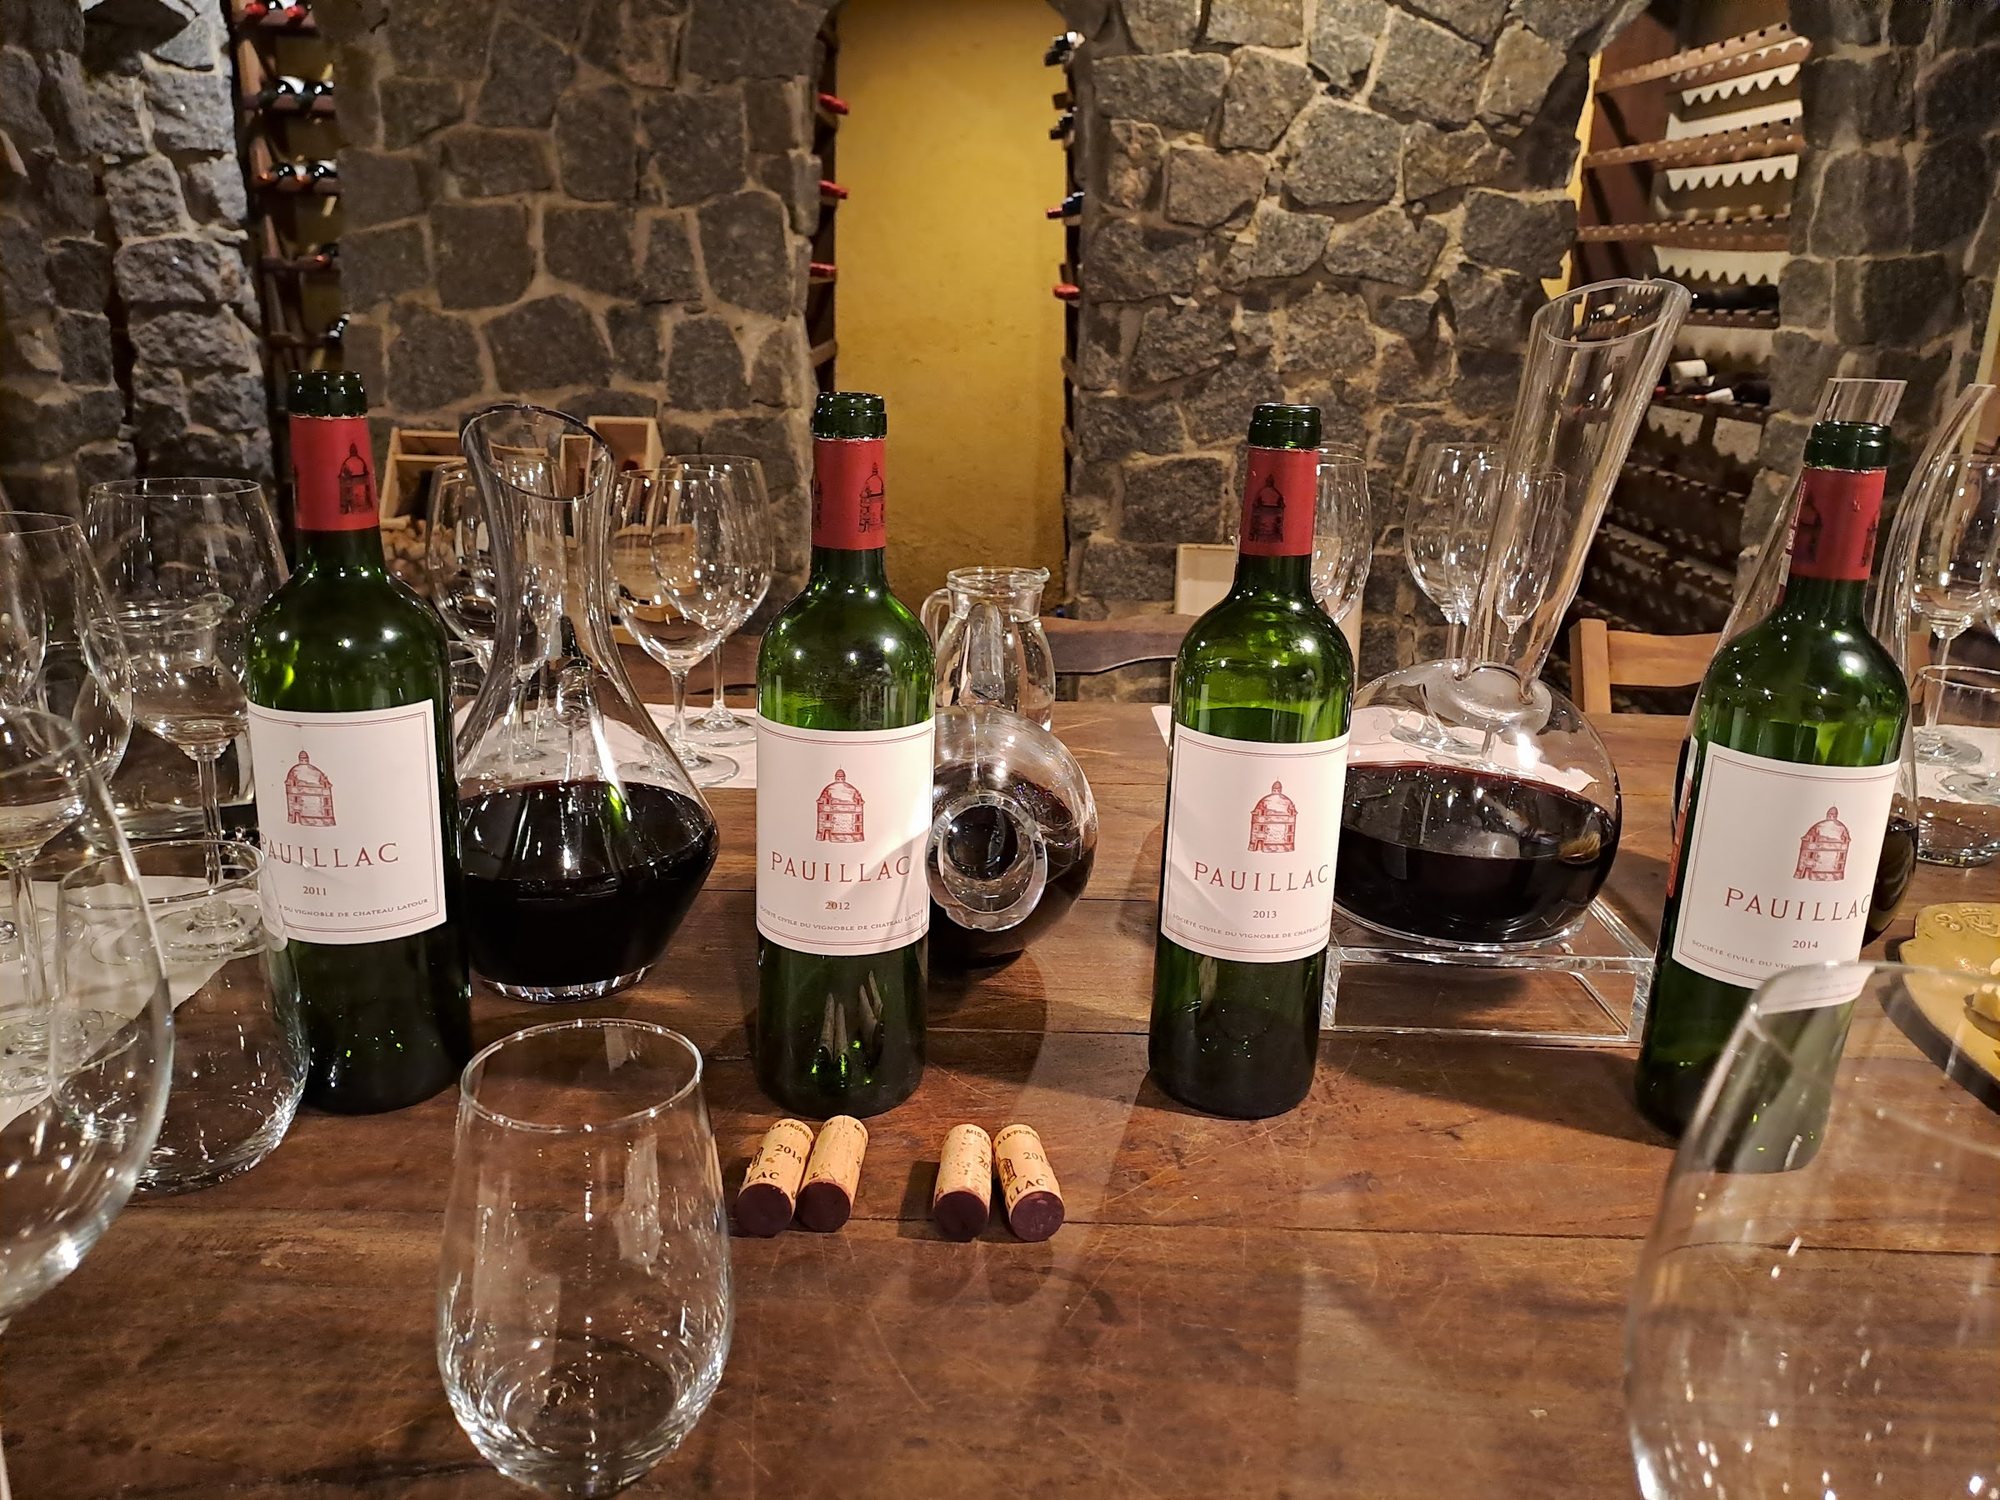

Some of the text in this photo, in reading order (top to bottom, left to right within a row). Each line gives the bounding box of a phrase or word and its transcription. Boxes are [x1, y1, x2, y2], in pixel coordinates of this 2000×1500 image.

[261, 833, 399, 868] PAUILLAC
[771, 851, 911, 883] PAUILLAC
[1194, 861, 1328, 892] PAUILLAC
[303, 886, 327, 896] 2011
[294, 908, 333, 917] VIGNOBLE
[353, 907, 394, 917] CHATEAU
[397, 899, 428, 911] LATOUR
[825, 901, 850, 910] 2012
[1724, 887, 1870, 921] PAUILLAC
[1252, 910, 1277, 919] 2013
[871, 918, 903, 930] CHATEAU
[1199, 924, 1221, 934] CIVILE
[1792, 940, 1818, 949] 2014
[1727, 953, 1756, 966] CIVILE
